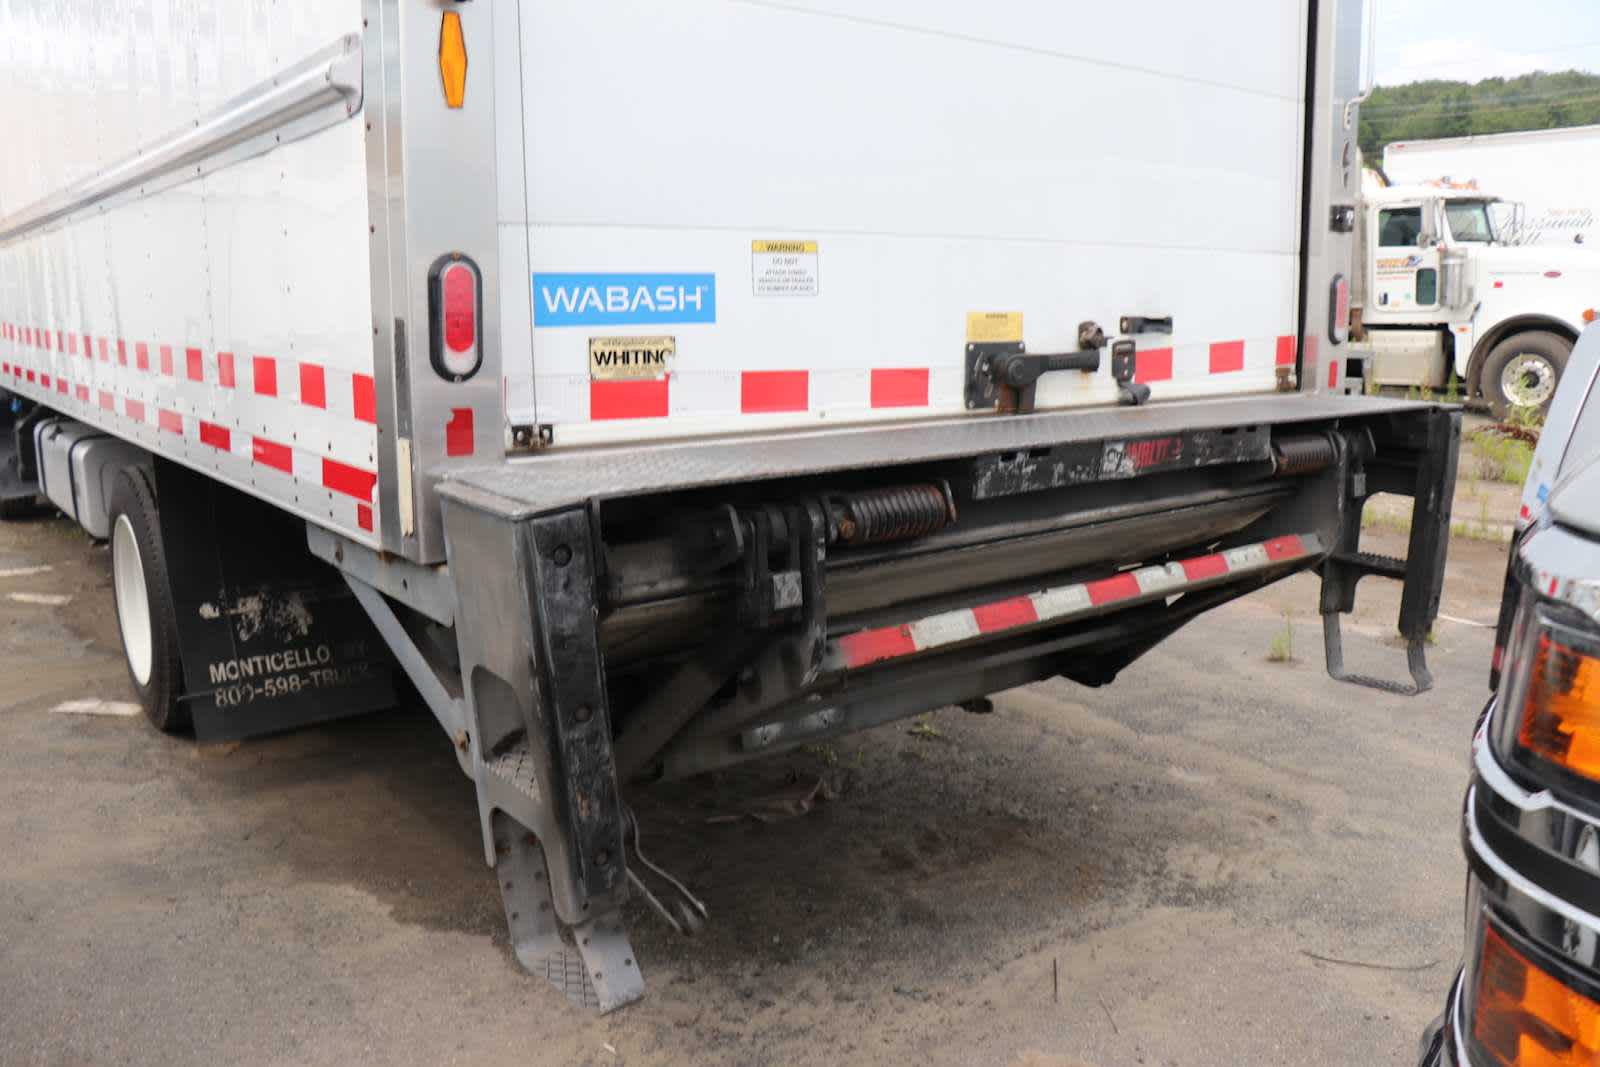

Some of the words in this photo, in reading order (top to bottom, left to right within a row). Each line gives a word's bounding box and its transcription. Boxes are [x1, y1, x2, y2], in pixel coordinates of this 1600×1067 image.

[767, 241, 805, 252] WARNING
[542, 285, 702, 313] WABASH
[209, 645, 330, 683] MONTICELLO
